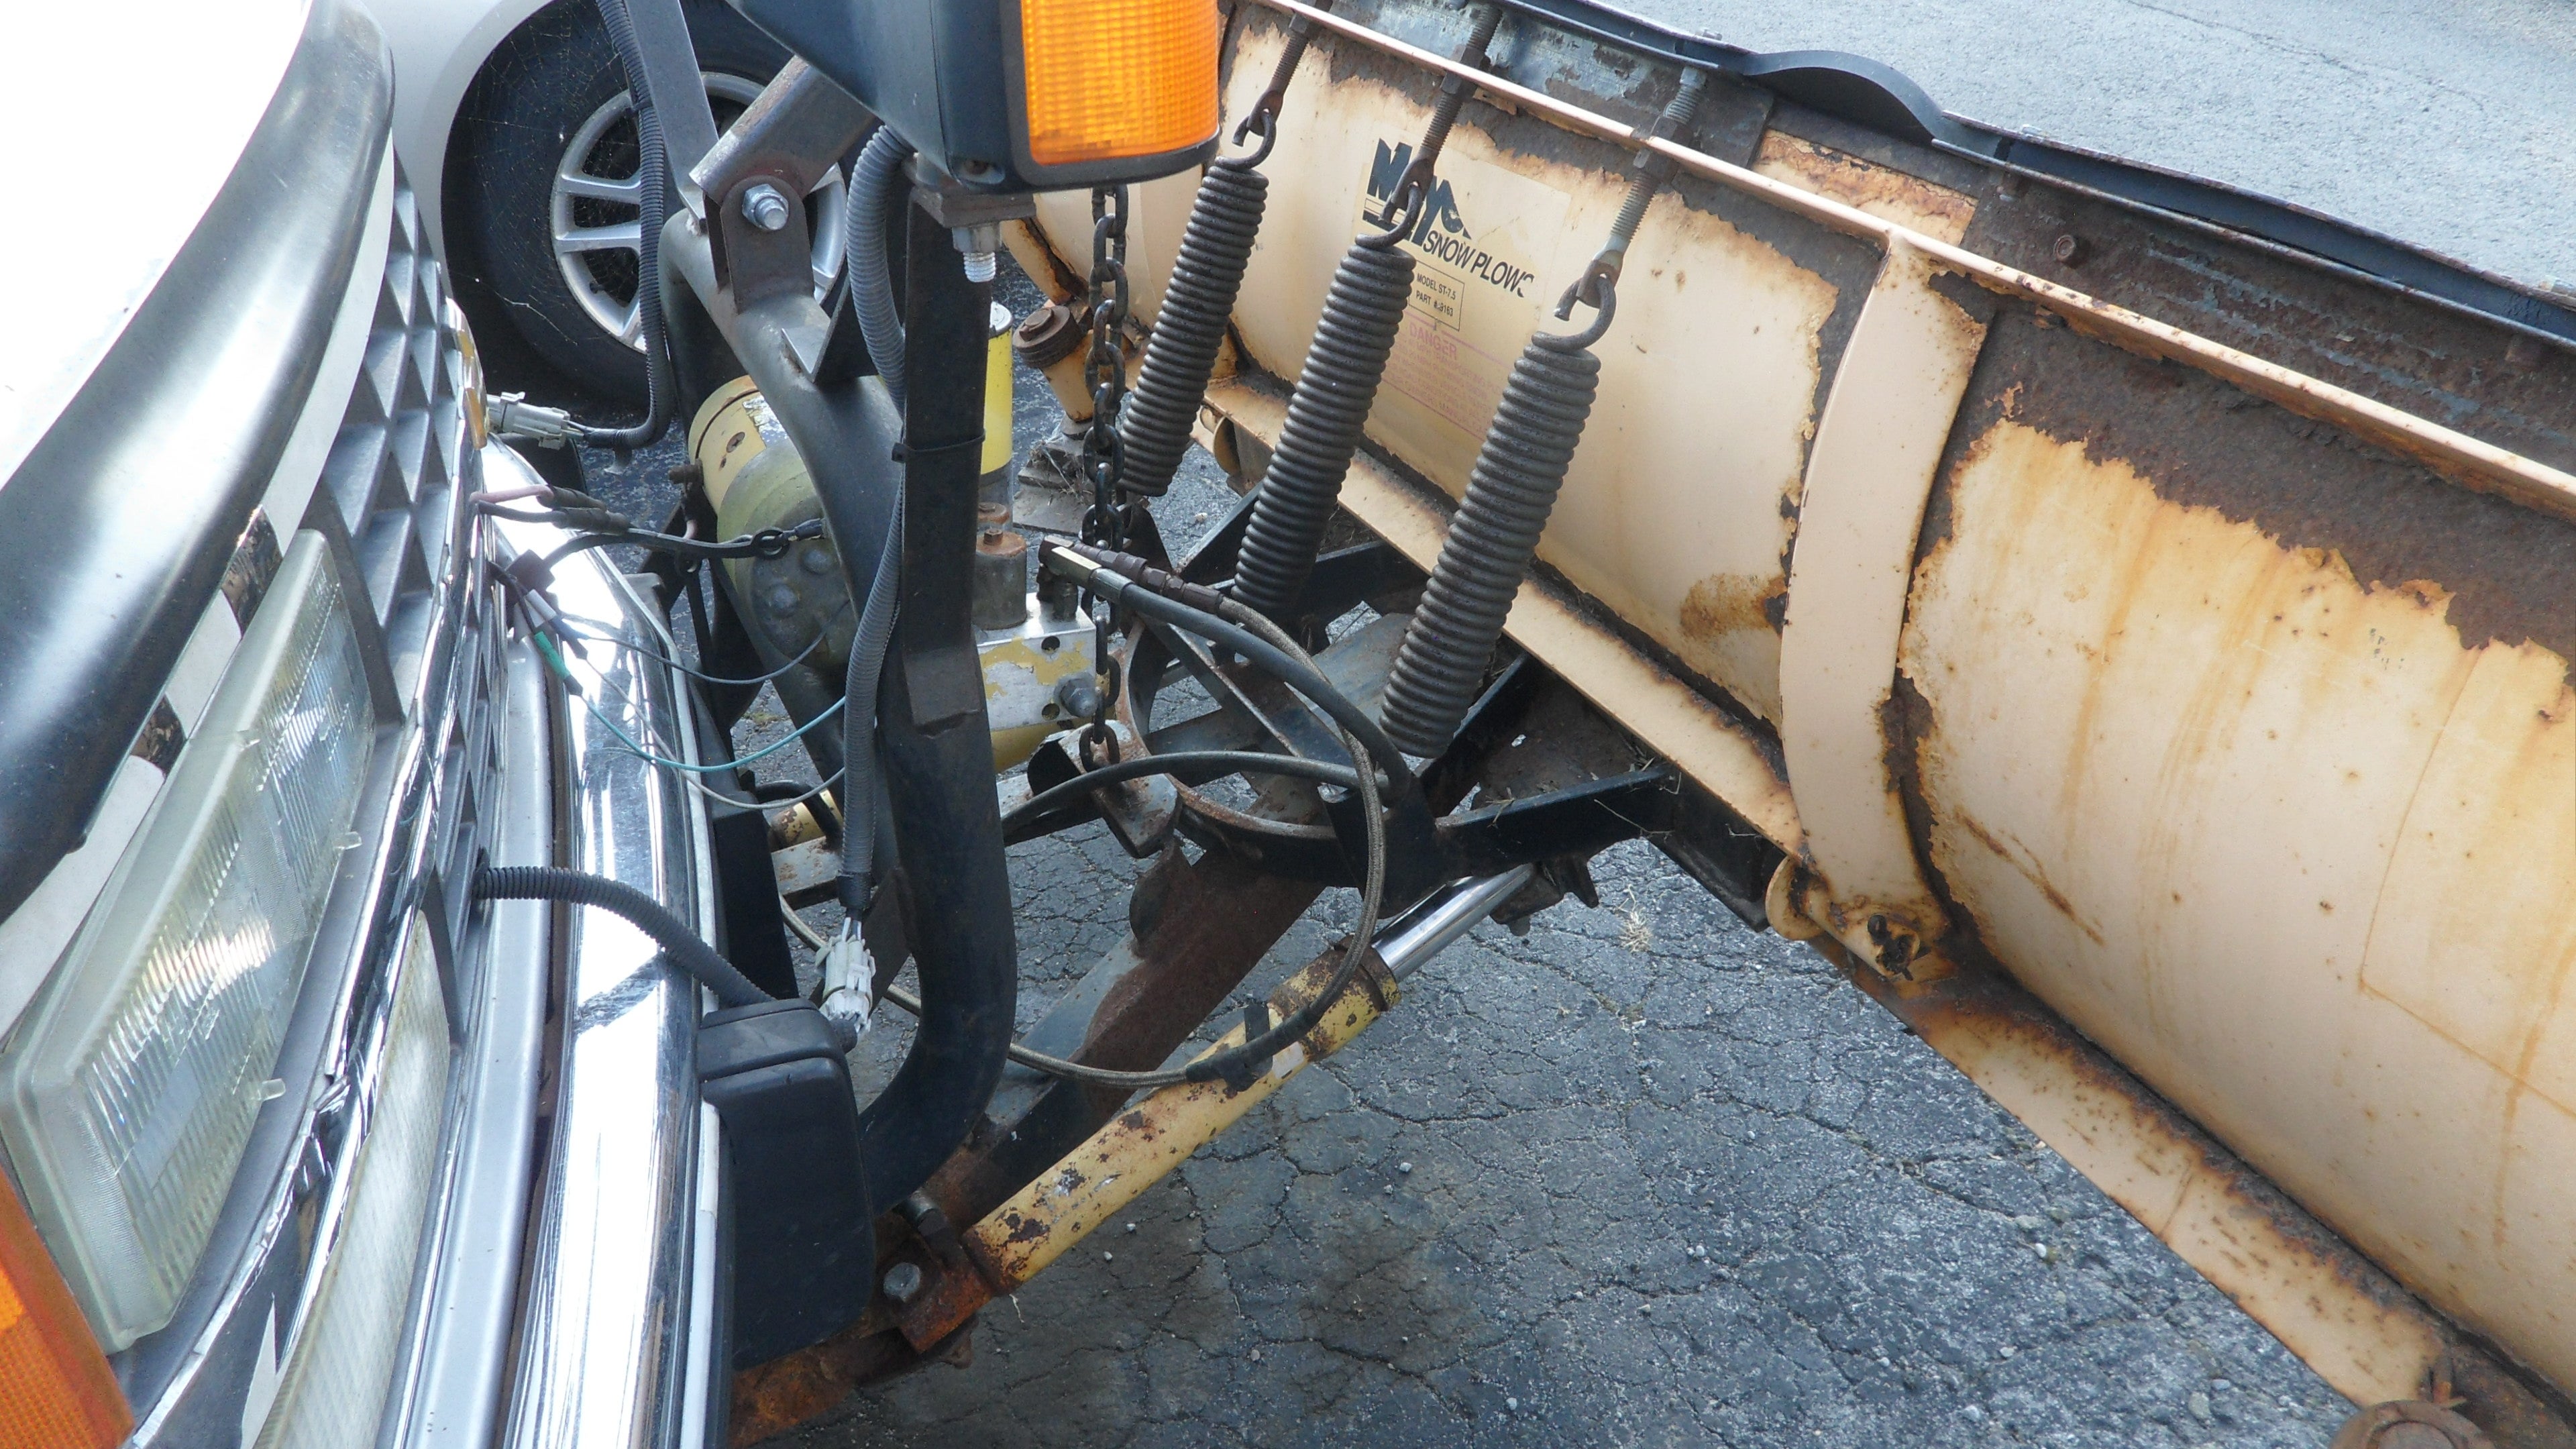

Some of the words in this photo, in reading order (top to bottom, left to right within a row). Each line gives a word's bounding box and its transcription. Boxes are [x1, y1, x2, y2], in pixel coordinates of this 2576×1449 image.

[1423, 230, 1476, 269] SNOW
[1415, 290, 1432, 305] PART
[1417, 273, 1437, 291] MODEL
[1438, 284, 1456, 301] ST-7.5
[1410, 322, 1456, 360] DANGER
